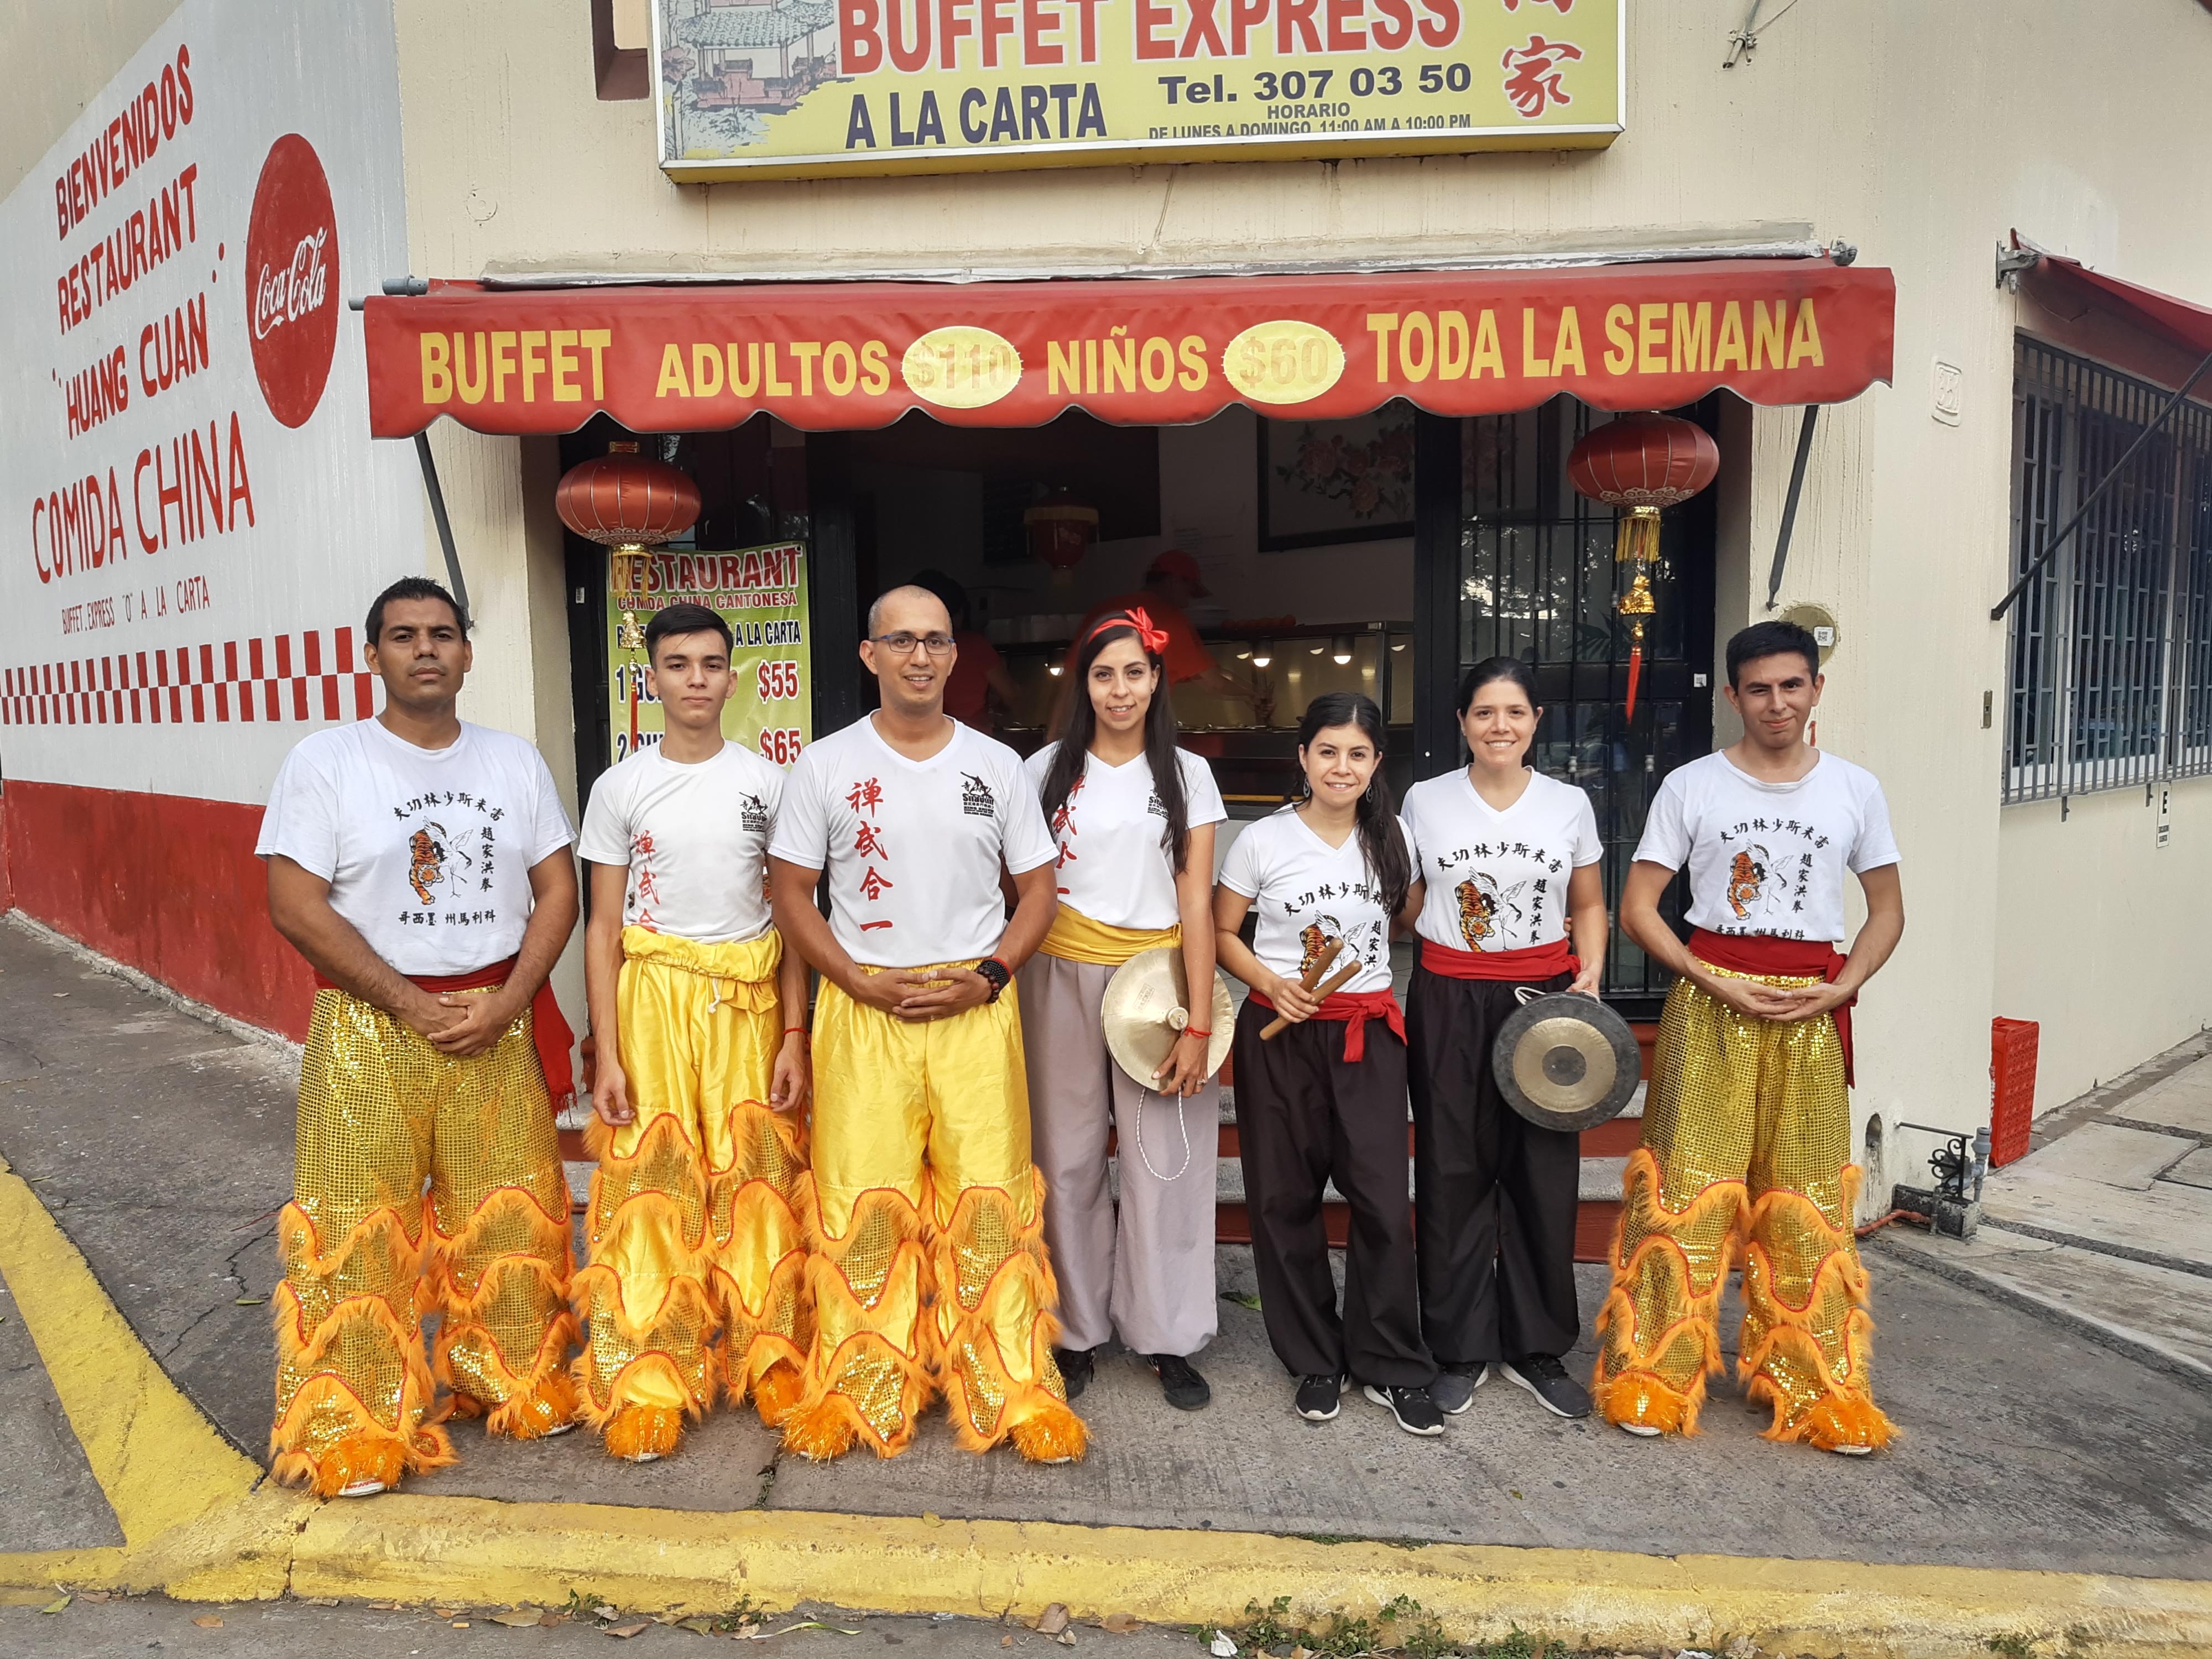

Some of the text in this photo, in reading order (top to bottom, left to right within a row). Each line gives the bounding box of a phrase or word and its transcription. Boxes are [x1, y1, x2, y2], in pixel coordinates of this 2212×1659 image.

[839, 0, 1460, 74] BUFFET EXPRESS
[1158, 62, 1471, 104] Tel. 307 03 50
[1267, 102, 1350, 119] HORARIO
[56, 44, 193, 241] BIENVENIDOS
[845, 83, 1107, 149] A LA CARTA
[1149, 114, 1471, 139] DE LUNES A DOMINGO 11:00 AM A 10:00 PM
[57, 163, 197, 335] RESTAURANT
[420, 298, 1824, 404] BUFFET ADULTOS $110 NIÑOS $60 TODA LA SEMANA
[33, 411, 255, 583] COMIDA CHINA
[87, 597, 115, 630] EXPRESS
[141, 589, 148, 620] A
[155, 586, 167, 617] LA
[176, 575, 210, 614] CARTA
[716, 591, 797, 609] CANTONESA
[735, 620, 802, 647] A LA CARTA
[616, 666, 625, 701] 1
[758, 661, 798, 702] $55
